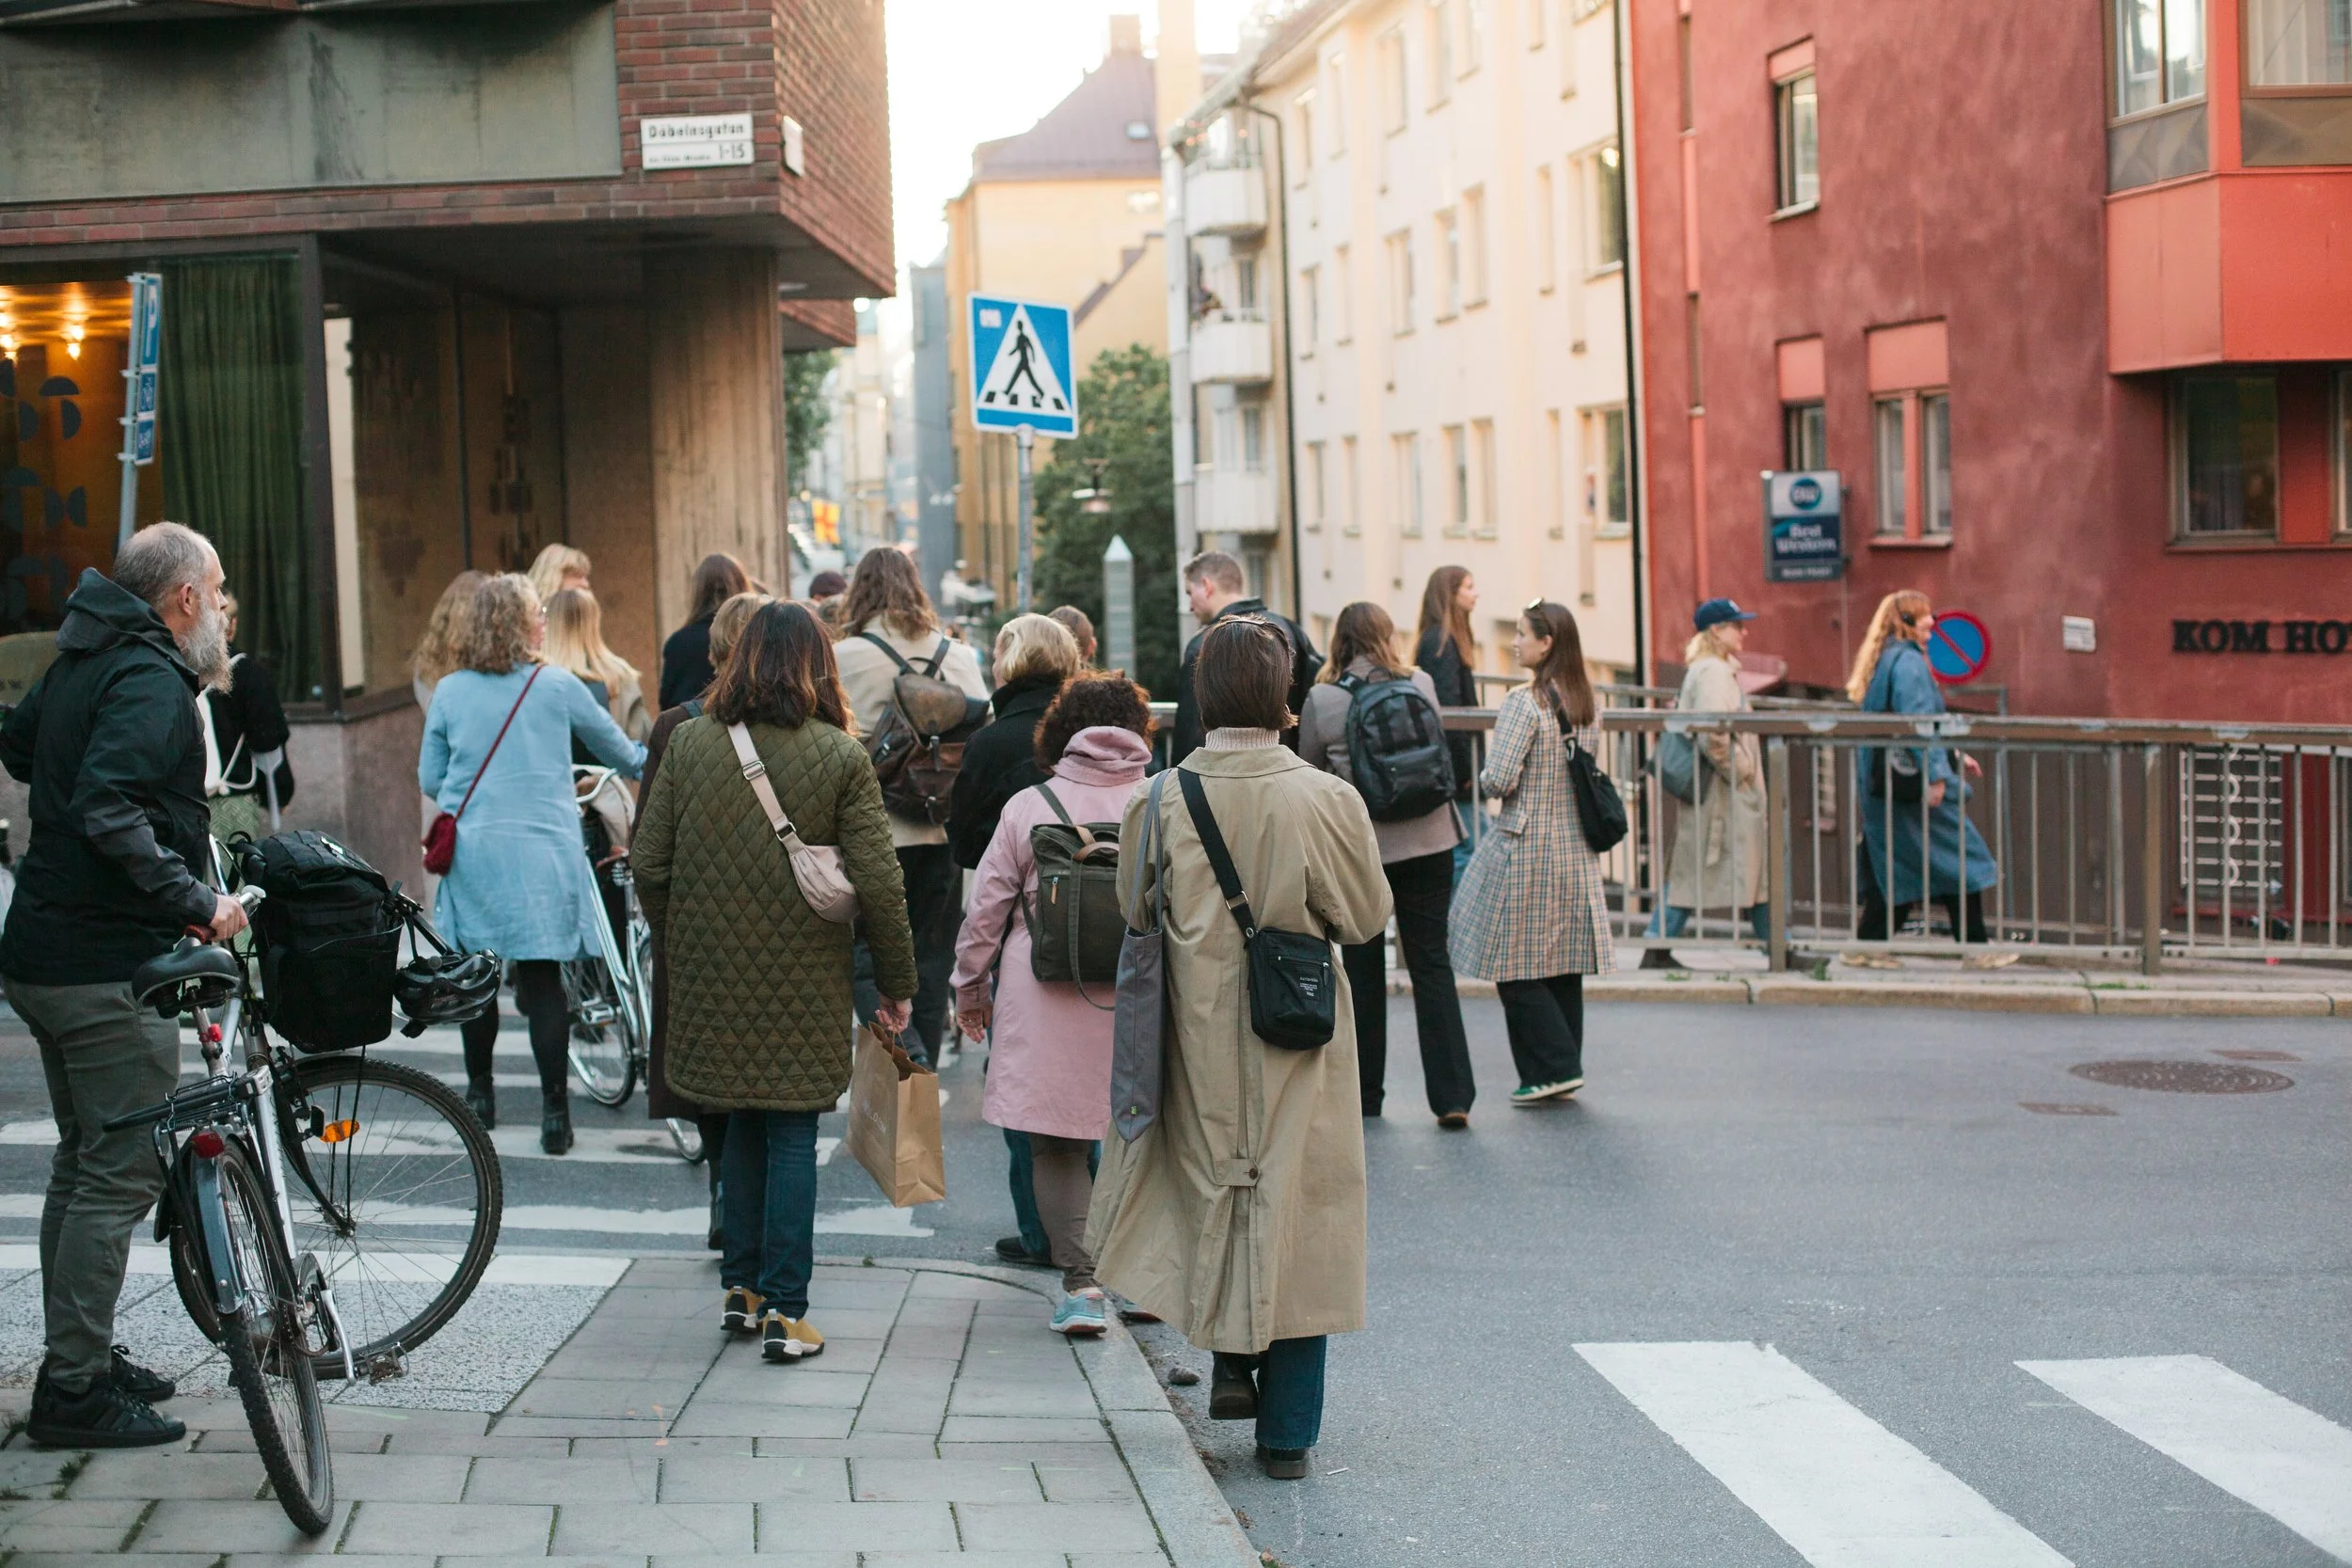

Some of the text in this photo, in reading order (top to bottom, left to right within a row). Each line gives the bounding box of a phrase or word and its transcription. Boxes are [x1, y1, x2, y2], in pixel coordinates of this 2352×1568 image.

[1789, 524, 1821, 537] Best
[1775, 538, 1836, 553] Western
[2172, 620, 2352, 654] KOM HO
